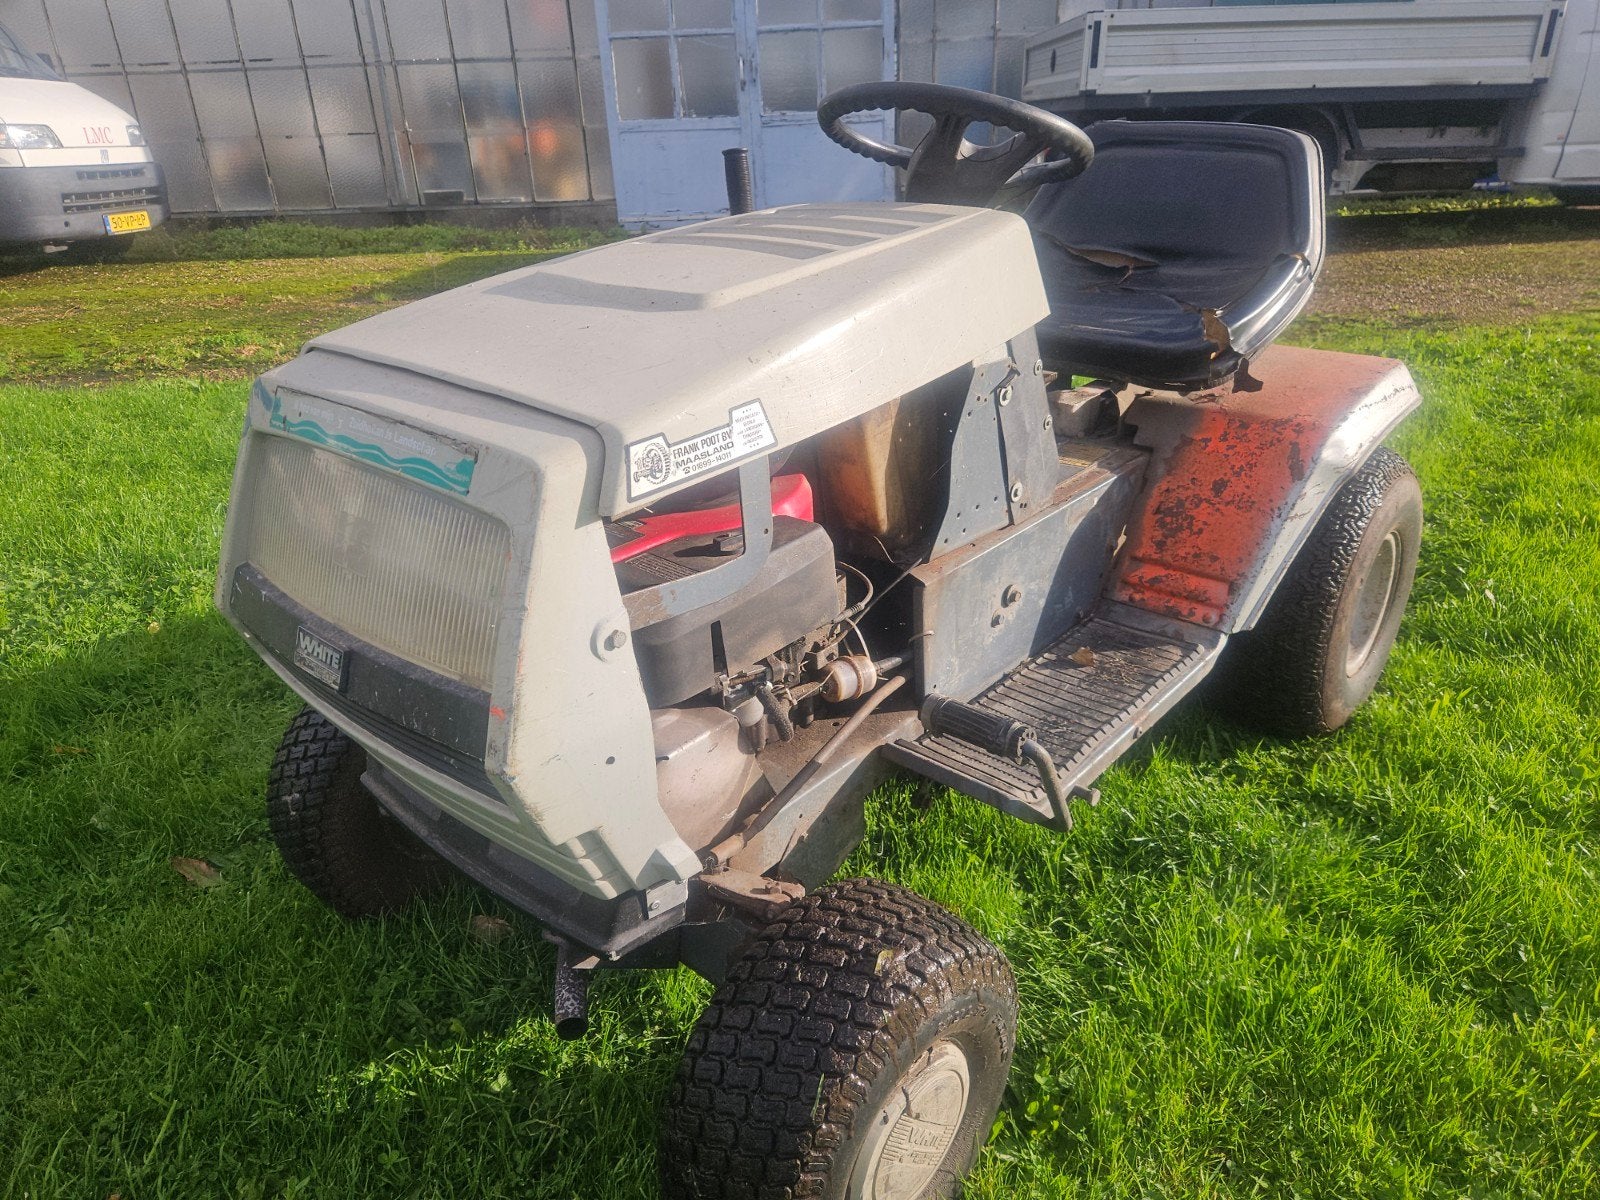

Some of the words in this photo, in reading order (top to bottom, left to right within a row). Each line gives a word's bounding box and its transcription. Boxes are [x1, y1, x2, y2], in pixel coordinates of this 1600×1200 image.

[83, 126, 114, 145] LMC
[673, 439, 700, 460] FRANK
[700, 434, 720, 451] POOT
[675, 441, 734, 469] MAASLAND
[300, 631, 341, 670] WHITE
